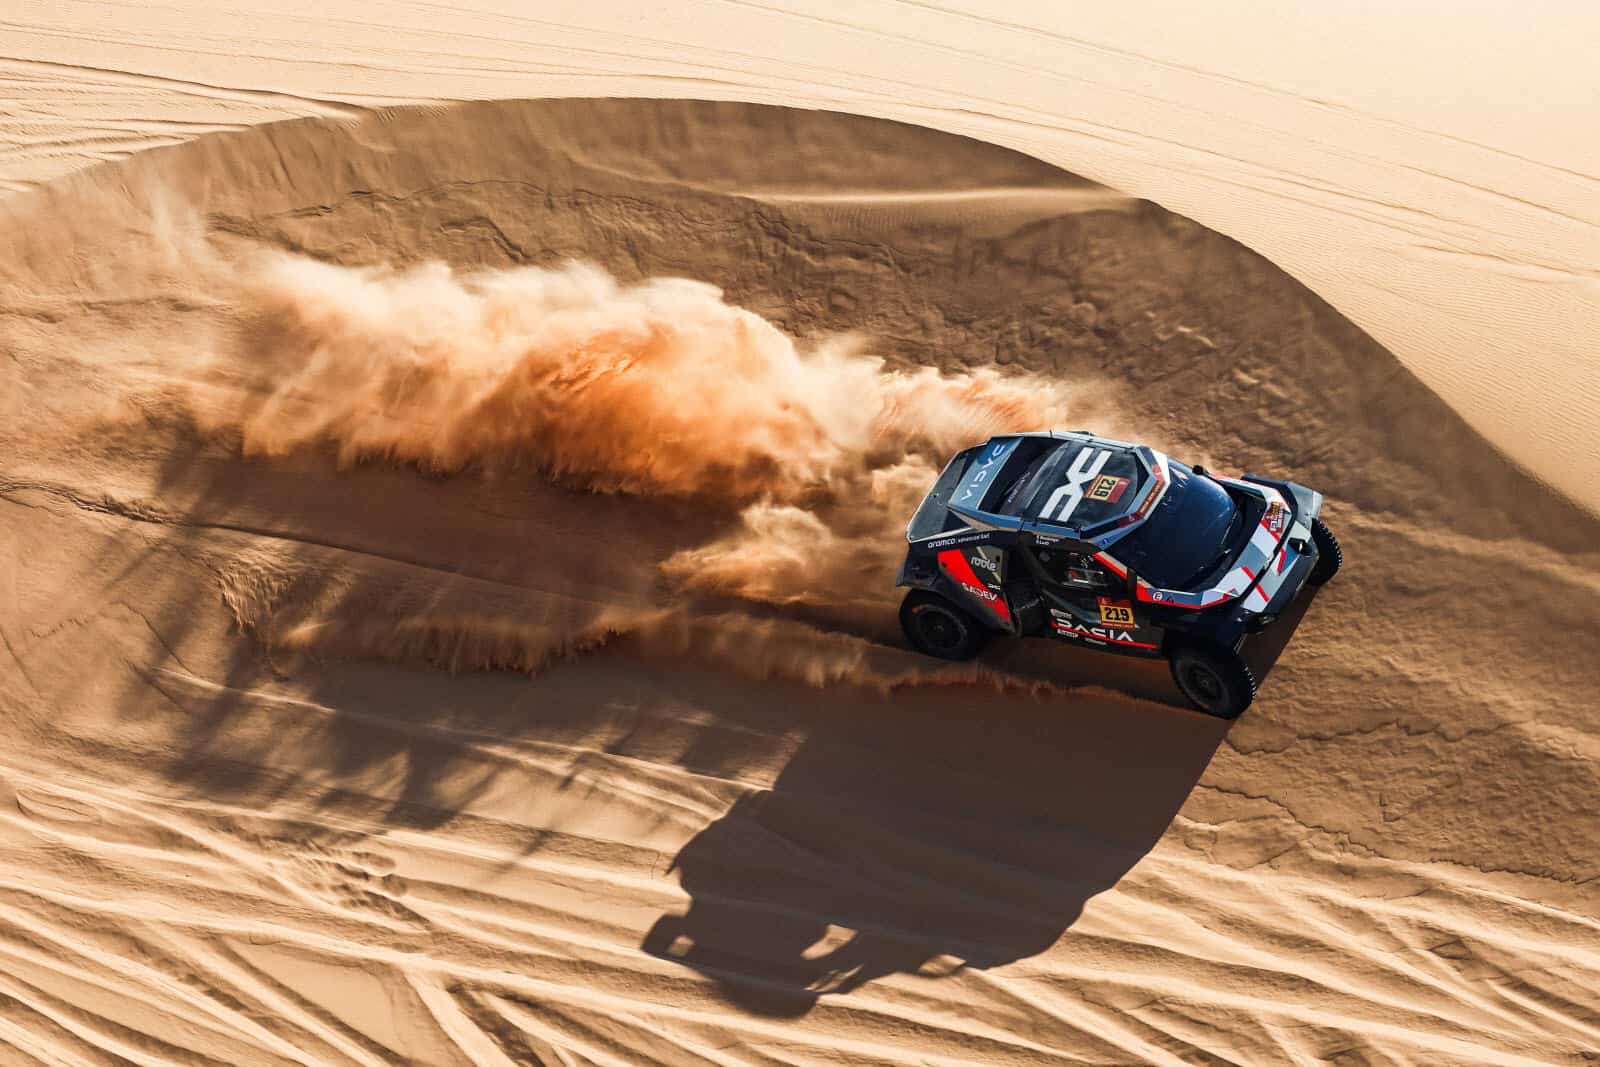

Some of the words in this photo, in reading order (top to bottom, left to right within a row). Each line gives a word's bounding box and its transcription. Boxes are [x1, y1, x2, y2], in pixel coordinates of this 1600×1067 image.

[961, 445, 1005, 500] DACIA
[1094, 478, 1116, 497] 219
[927, 538, 956, 549] aramco
[1104, 606, 1130, 622] 219
[1056, 618, 1134, 642] DACIA
